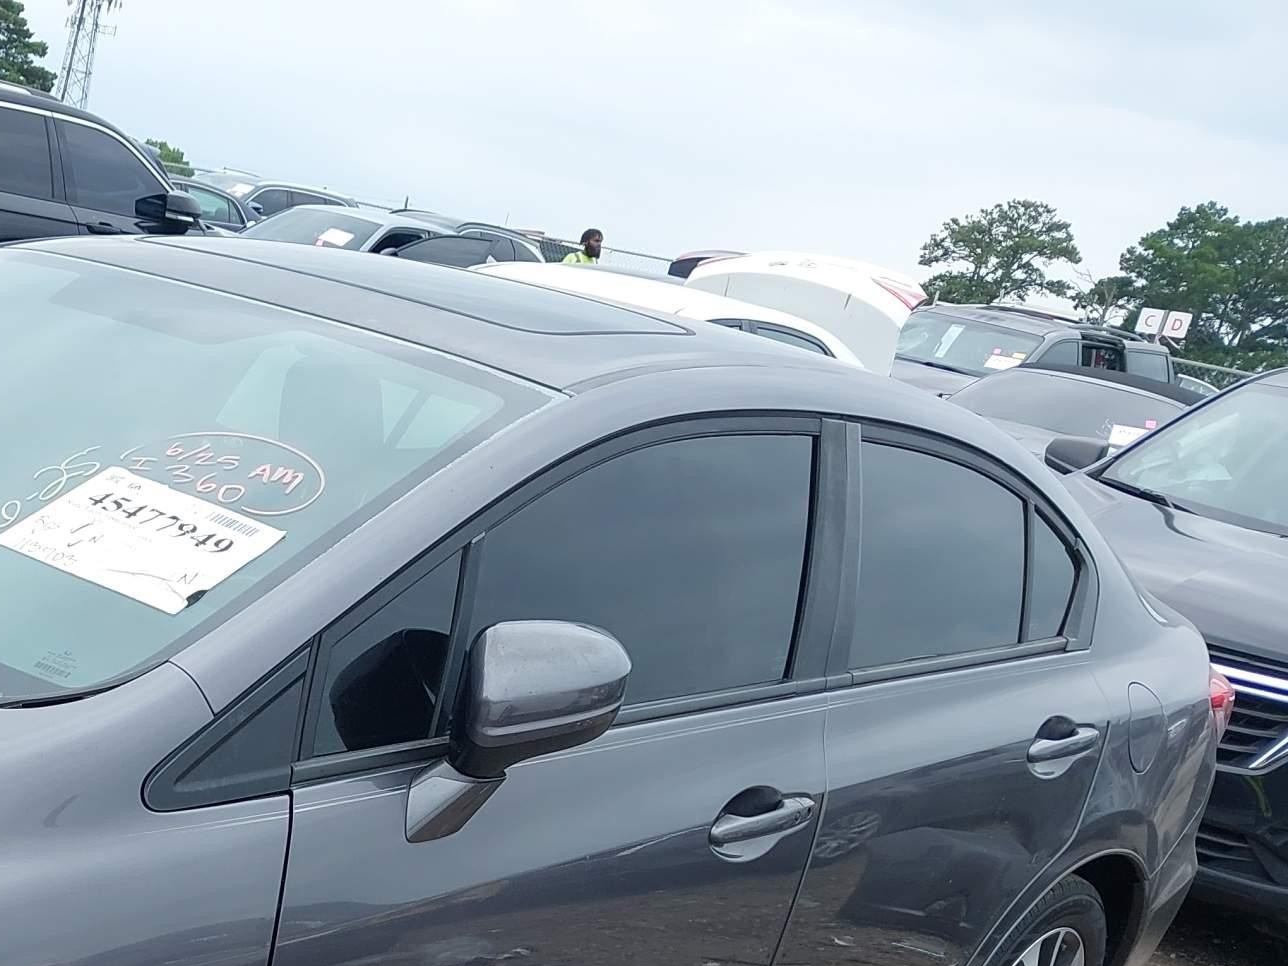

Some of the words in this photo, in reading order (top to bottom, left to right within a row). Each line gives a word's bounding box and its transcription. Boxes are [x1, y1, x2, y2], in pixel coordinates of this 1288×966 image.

[1144, 314, 1157, 327] C
[1171, 318, 1183, 331] D
[165, 441, 241, 470] 6/25
[247, 463, 305, 495] AM
[165, 464, 246, 503] 360
[88, 492, 235, 553] 45477949
